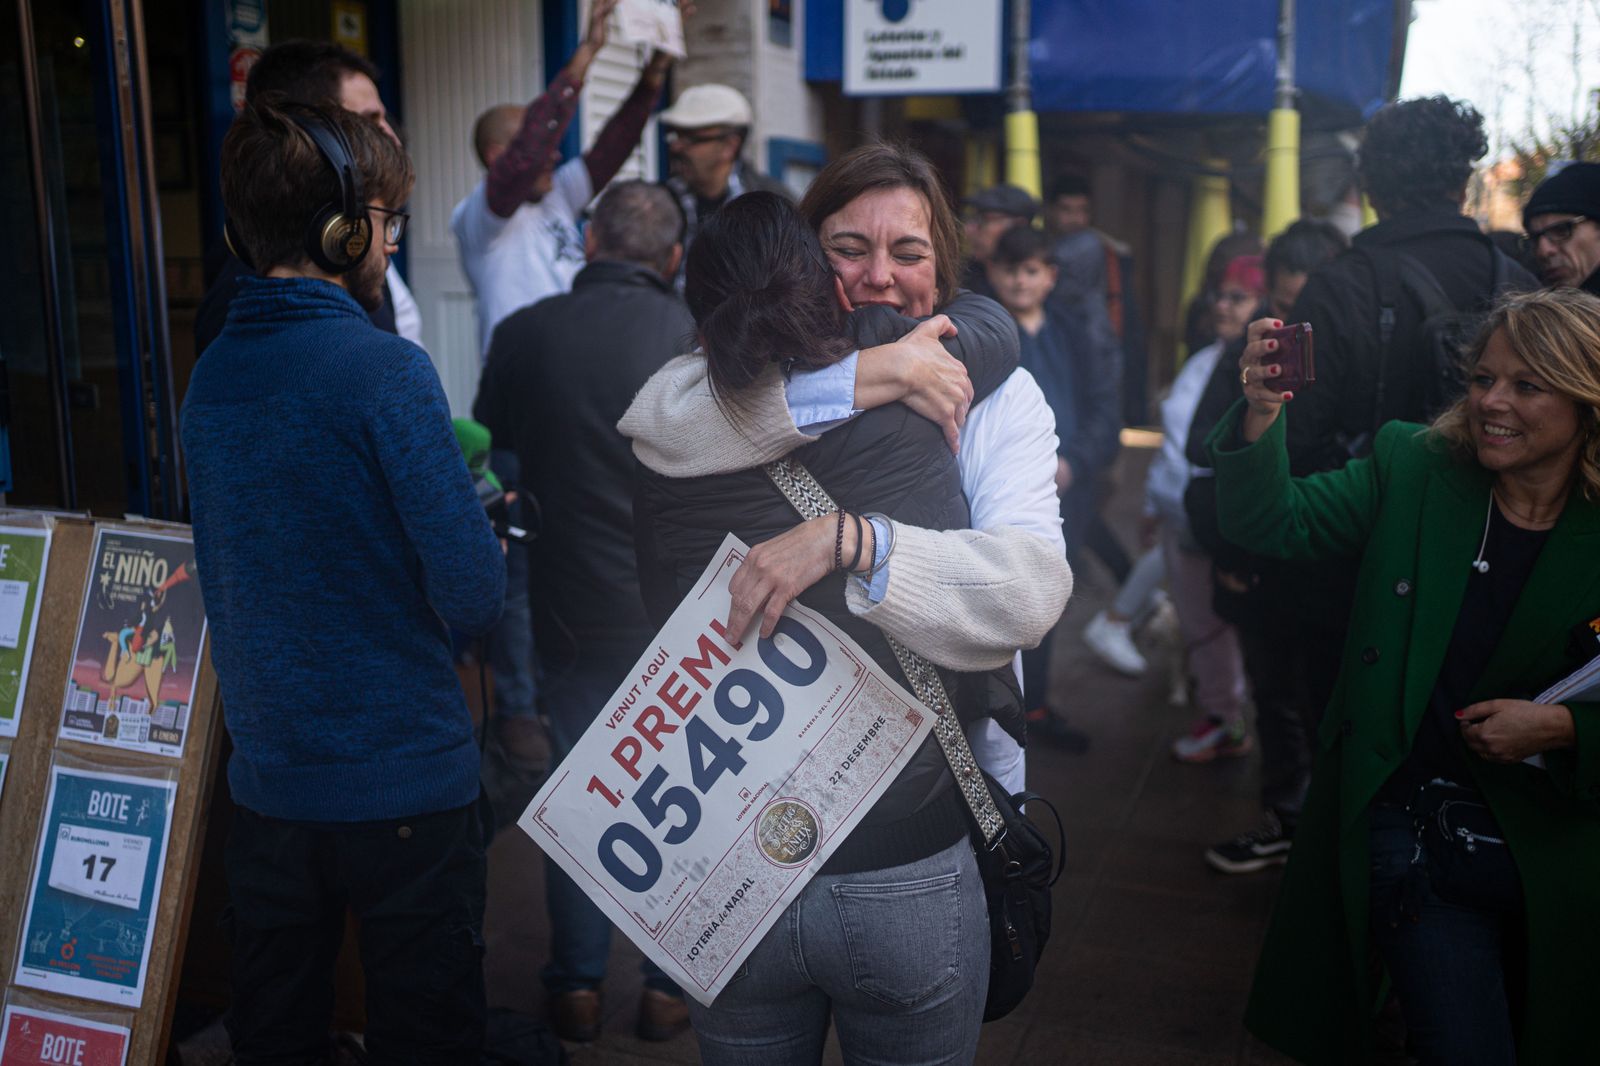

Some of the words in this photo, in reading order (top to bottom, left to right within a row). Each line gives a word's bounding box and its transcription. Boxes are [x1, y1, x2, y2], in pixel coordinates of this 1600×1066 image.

[102, 552, 116, 569] EL
[114, 549, 168, 589] NIÑO
[605, 684, 642, 730] VENUT
[641, 646, 670, 687] AQUÍ
[610, 618, 744, 782] PREMI
[818, 704, 828, 716] DEL
[596, 615, 828, 894] 05490
[829, 770, 843, 785] 22
[841, 715, 886, 771] DESEMBRE
[87, 790, 132, 821] BOTE
[750, 782, 769, 804] NACIONAL
[82, 854, 117, 882] 17
[686, 921, 720, 961] LOTERIA
[718, 911, 728, 924] de
[724, 877, 755, 912] NADAL
[40, 1033, 86, 1066] BOTE
